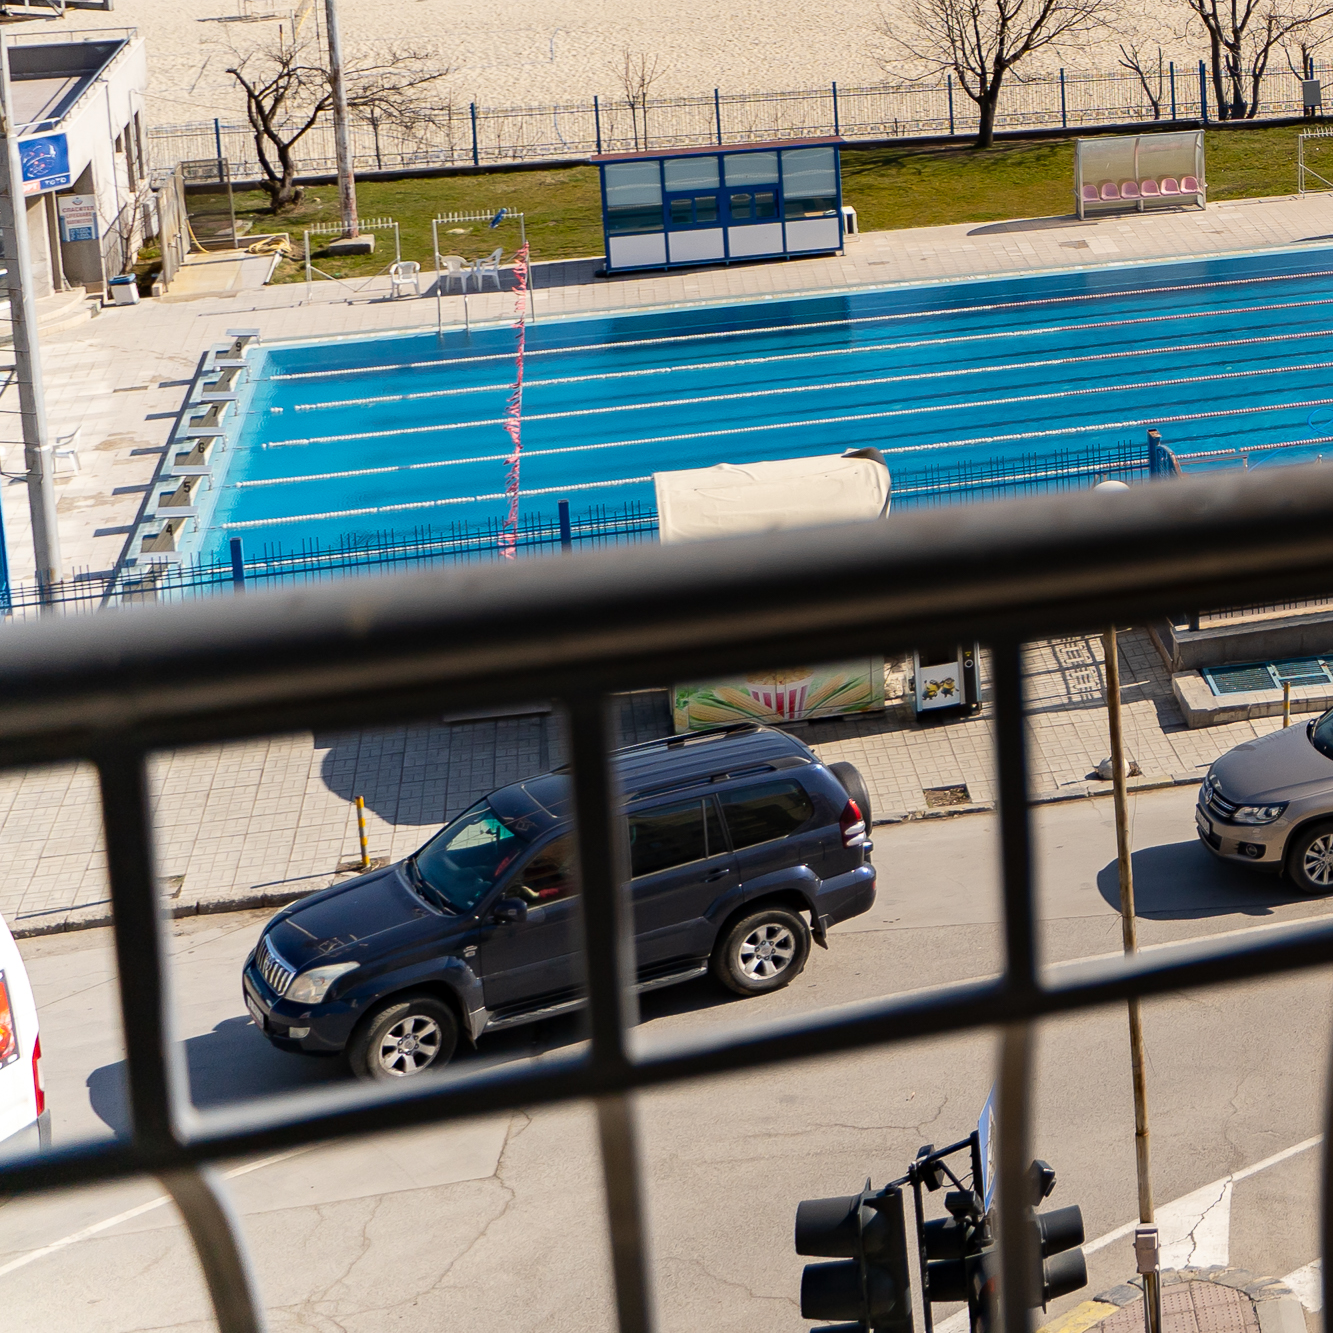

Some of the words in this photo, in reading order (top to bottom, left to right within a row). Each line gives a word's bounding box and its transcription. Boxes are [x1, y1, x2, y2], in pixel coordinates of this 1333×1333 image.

[235, 342, 242, 352] 9
[197, 443, 205, 454] 6
[183, 481, 191, 493] 5
[165, 523, 173, 536] 4
